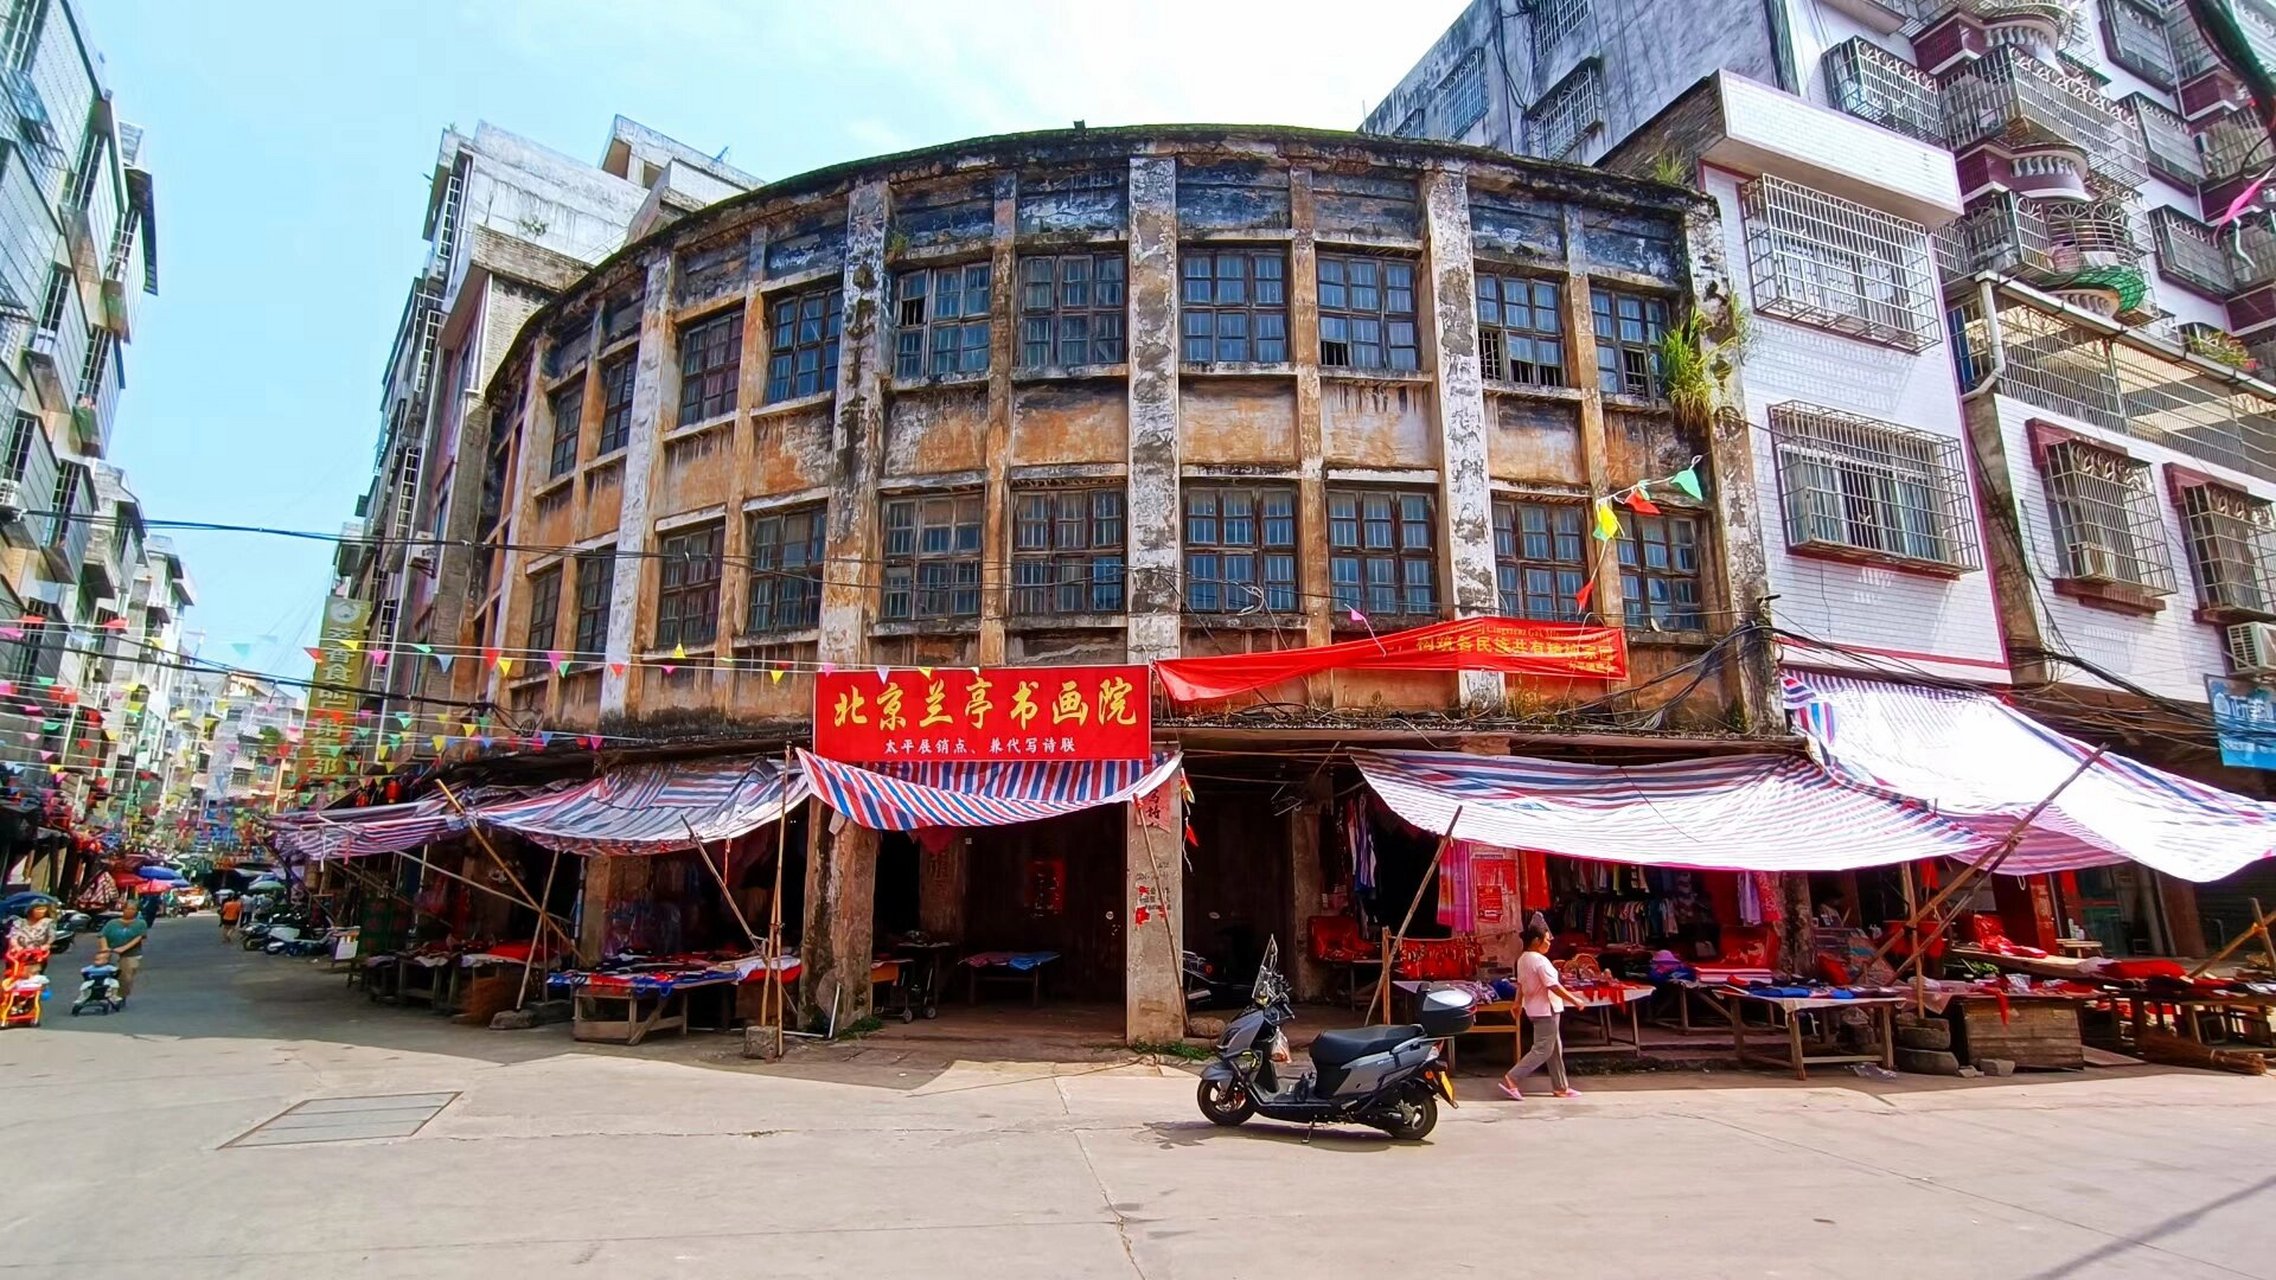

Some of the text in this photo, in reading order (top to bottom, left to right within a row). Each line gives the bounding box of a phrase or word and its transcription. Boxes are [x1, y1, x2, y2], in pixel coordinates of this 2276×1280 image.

[834, 676, 1137, 731] 北京兰亭书画院
[884, 737, 1076, 755] 太平展销点、兼代写诗联
